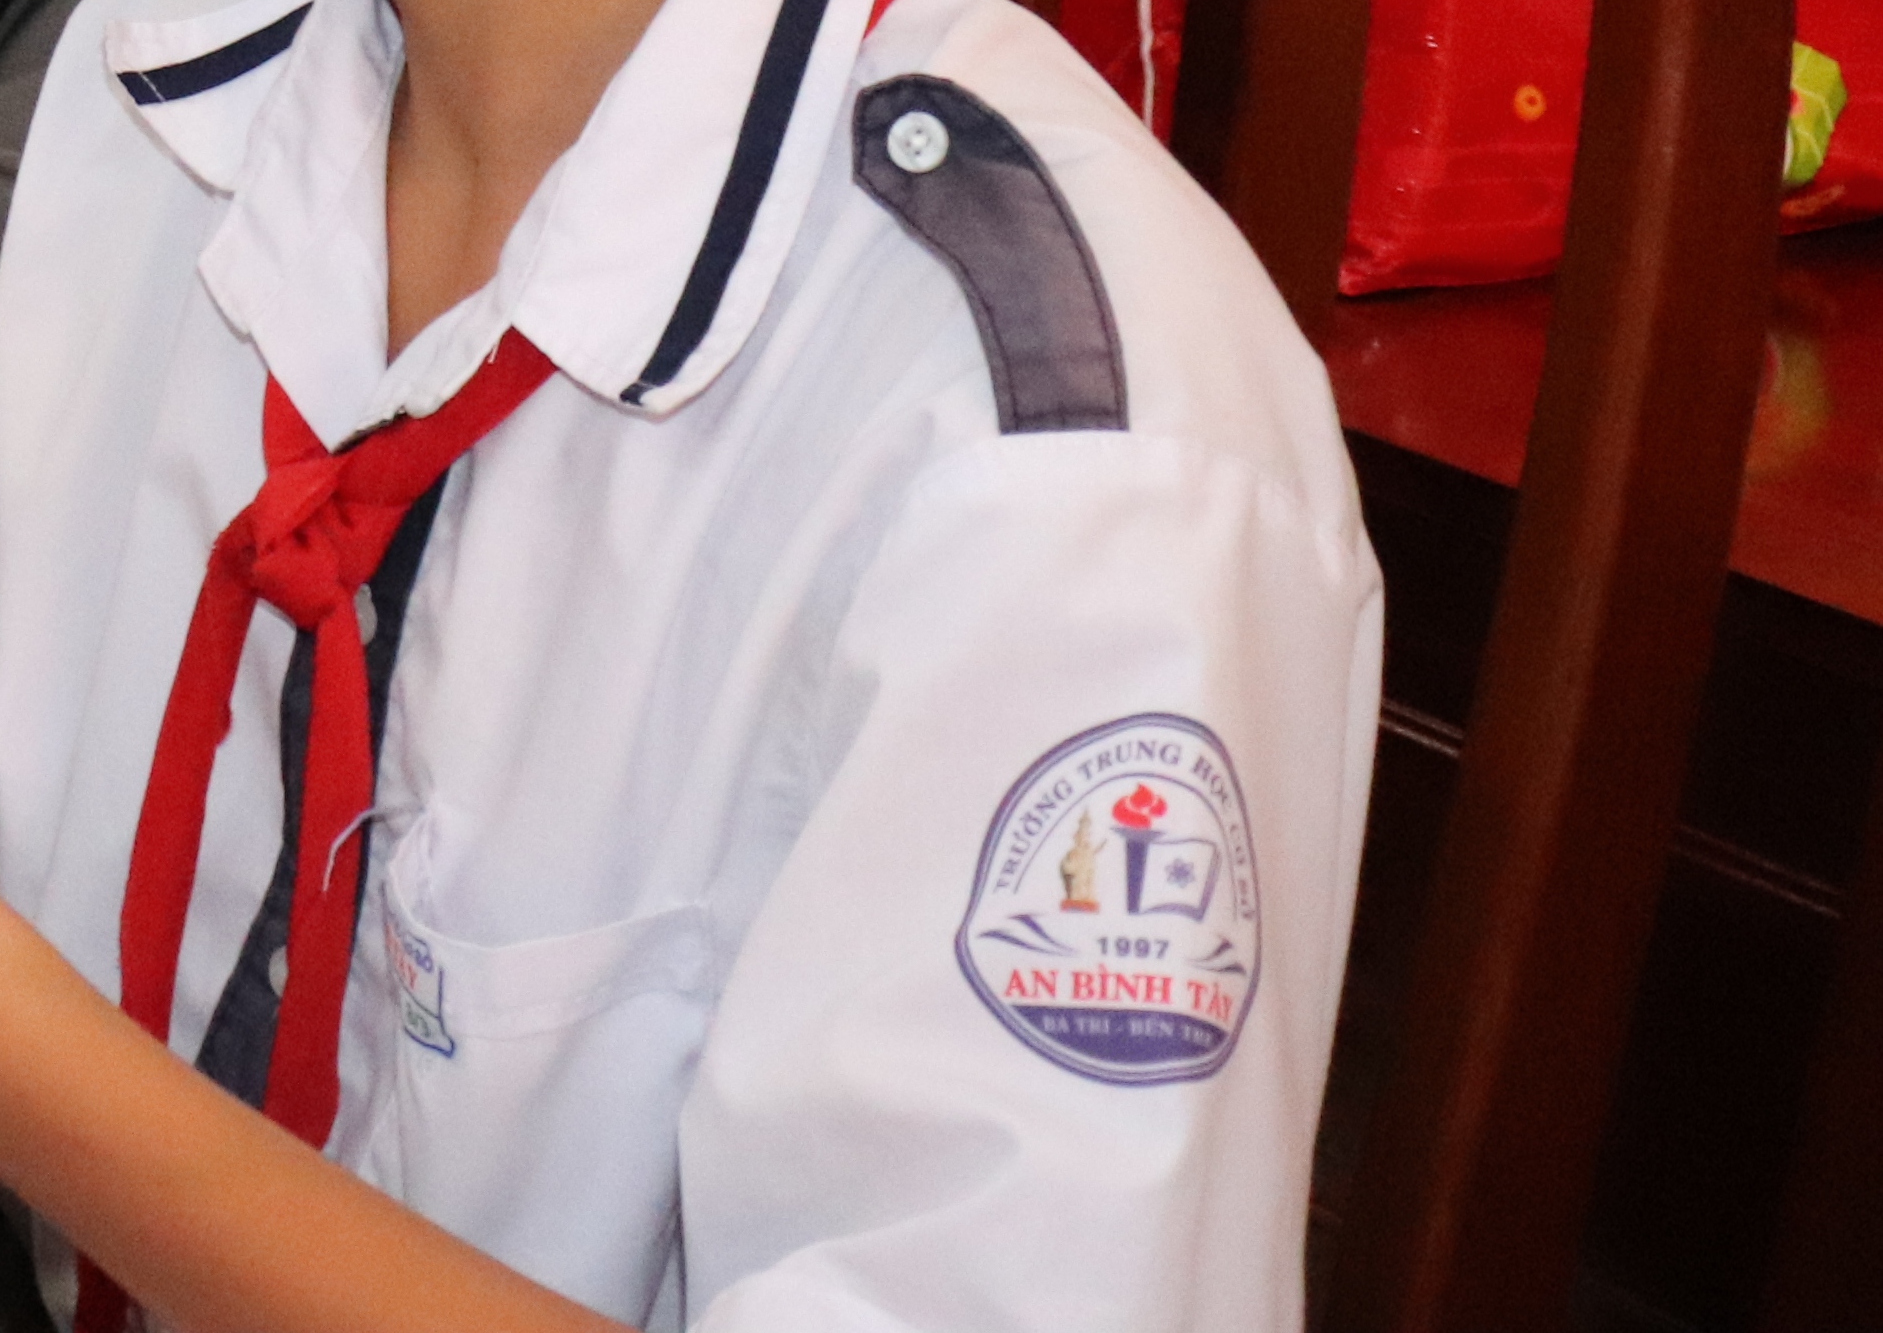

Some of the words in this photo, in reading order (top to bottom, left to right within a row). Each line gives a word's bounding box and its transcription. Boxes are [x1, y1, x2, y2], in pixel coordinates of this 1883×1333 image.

[1077, 740, 1182, 781] TRUNG
[1097, 936, 1169, 959] 1997
[1004, 968, 1059, 999] AN
[1071, 962, 1174, 1005] BÌNH
